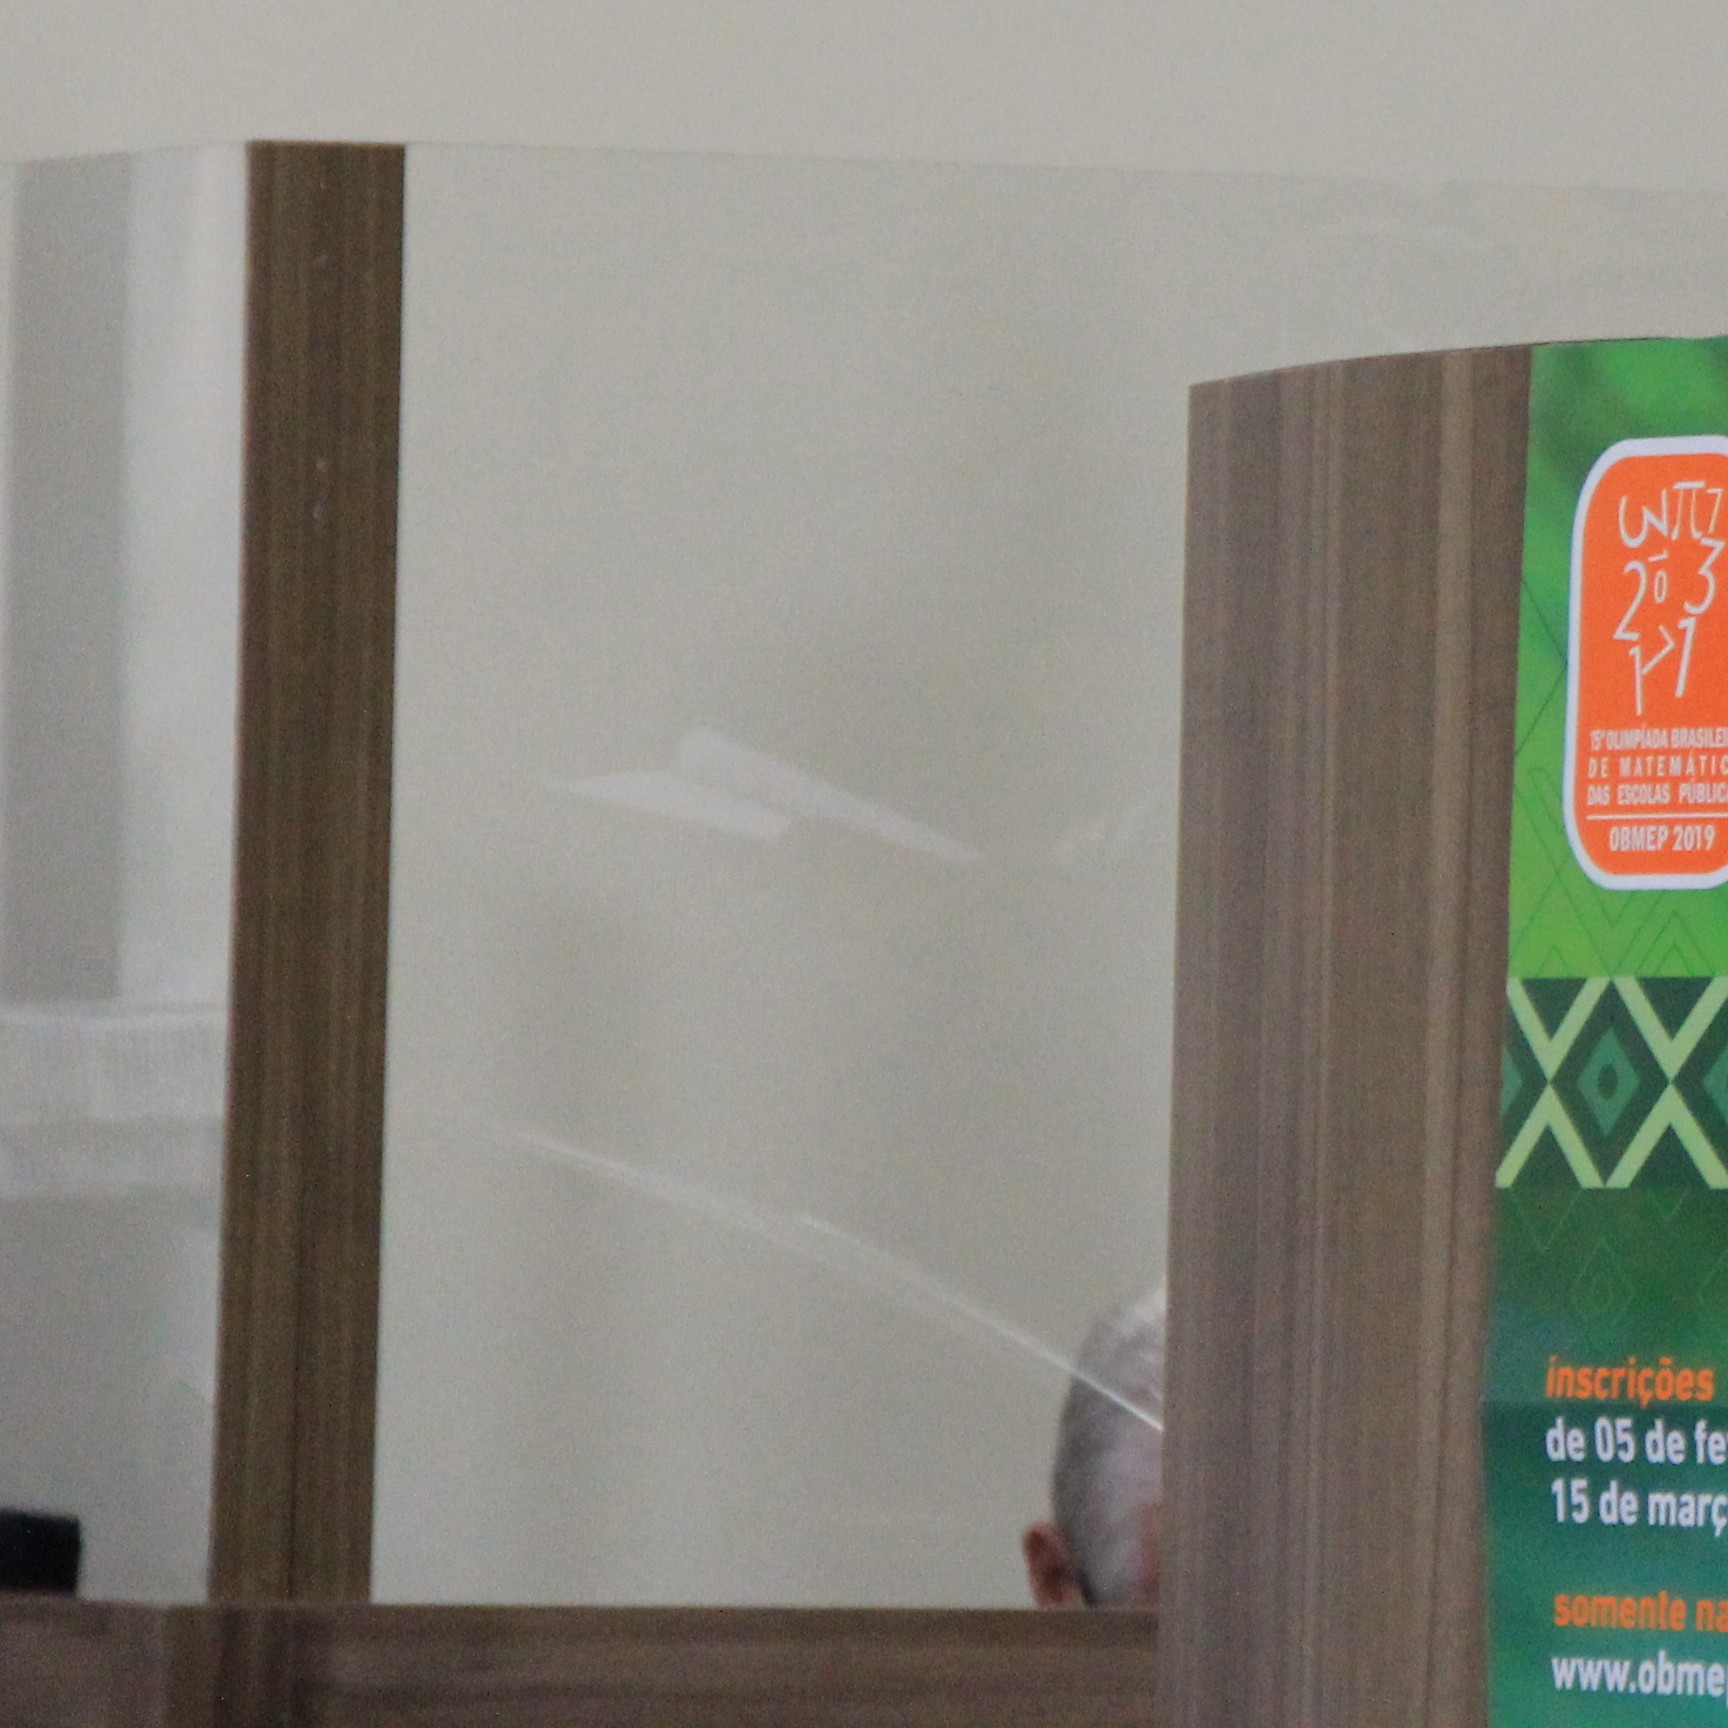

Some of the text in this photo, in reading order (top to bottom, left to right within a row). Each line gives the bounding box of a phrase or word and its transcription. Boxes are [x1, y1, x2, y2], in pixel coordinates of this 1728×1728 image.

[1587, 756, 1610, 780] DE
[1617, 783, 1671, 806] ESCOLAS
[1609, 824, 1717, 852] OBMEP 2019
[1545, 1355, 1715, 1407] inscrições
[1545, 1416, 1587, 1462] de
[1594, 1415, 1637, 1463] 05
[1645, 1418, 1687, 1465] de
[1551, 1477, 1591, 1524] 15
[1599, 1479, 1640, 1525] de
[1554, 1590, 1688, 1631] somente
